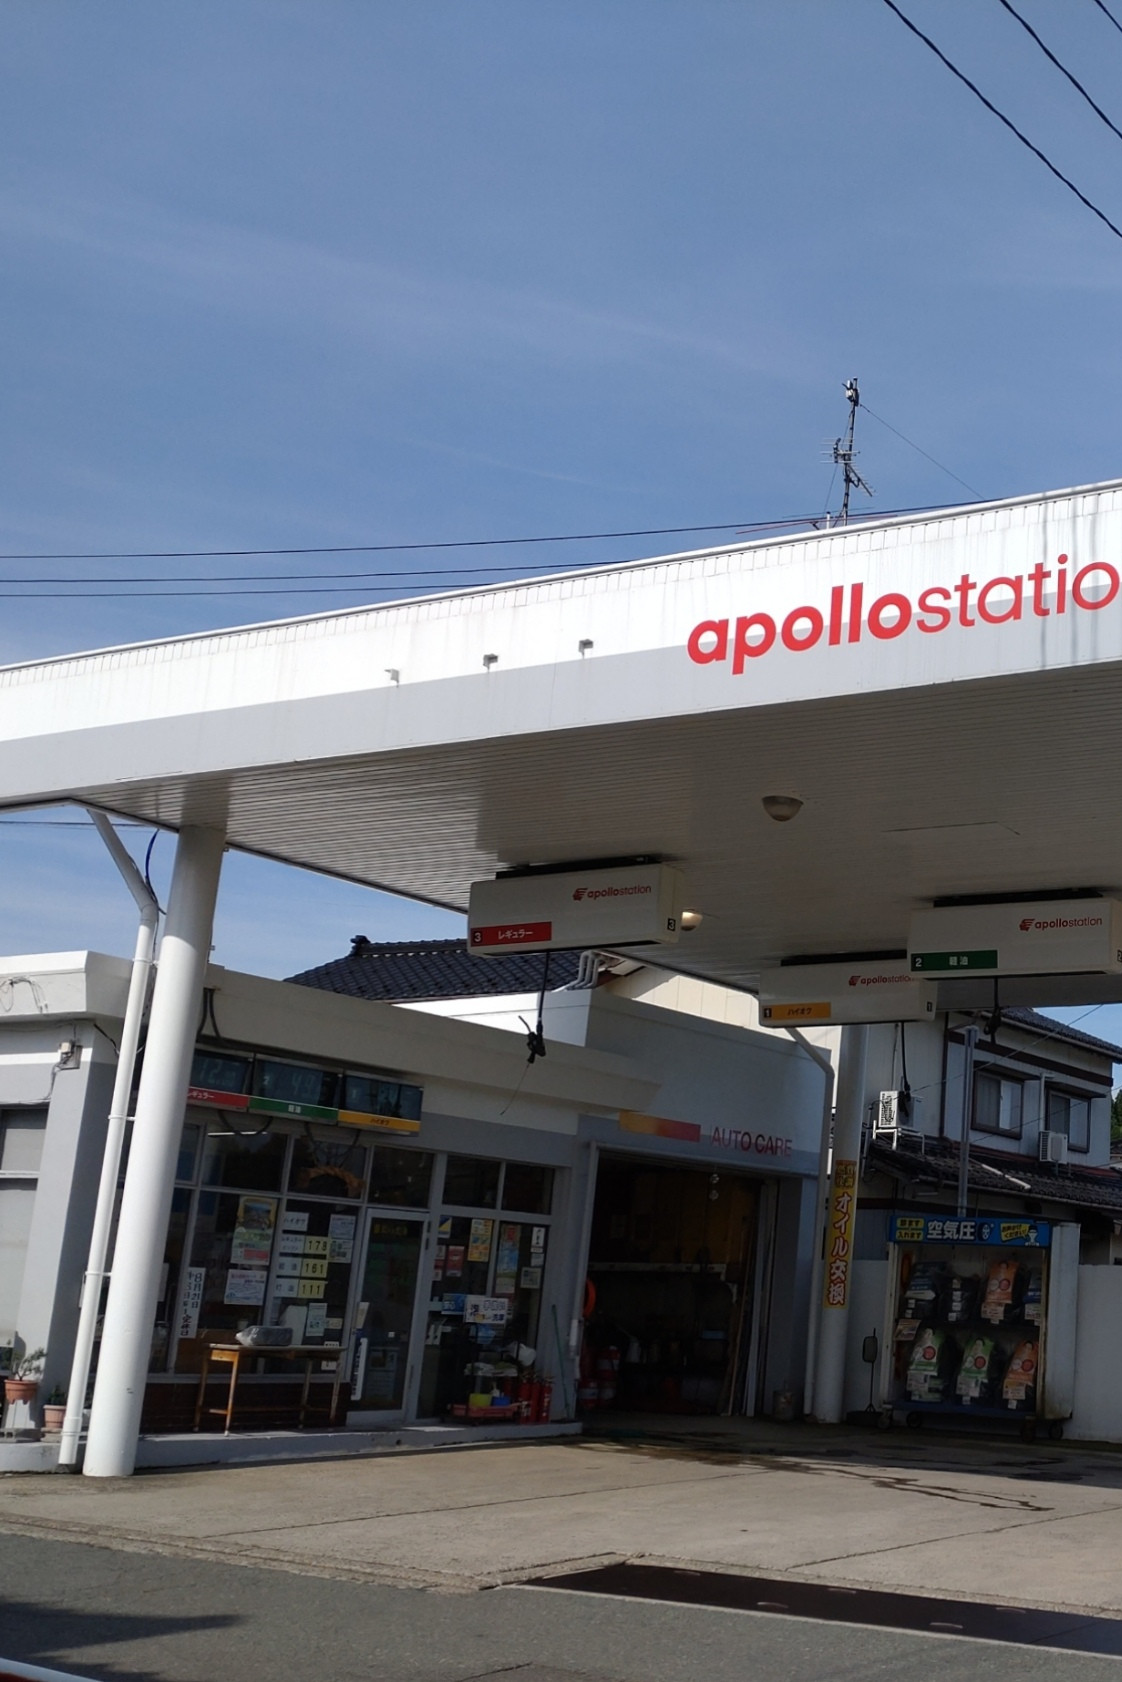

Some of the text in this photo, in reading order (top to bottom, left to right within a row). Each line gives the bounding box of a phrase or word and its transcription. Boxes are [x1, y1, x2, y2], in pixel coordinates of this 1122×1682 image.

[587, 884, 652, 900] apollostation
[668, 919, 675, 930] 3
[1035, 916, 1103, 931] apollostation
[474, 928, 533, 943] 3 レギュラー
[914, 957, 923, 968] 2
[711, 1127, 792, 1156] AUTO CARE
[926, 1219, 977, 1241] 空気圧
[308, 1240, 327, 1252] 178
[828, 1192, 852, 1305] オイル交換
[305, 1262, 324, 1274] 161
[302, 1284, 321, 1296] 111
